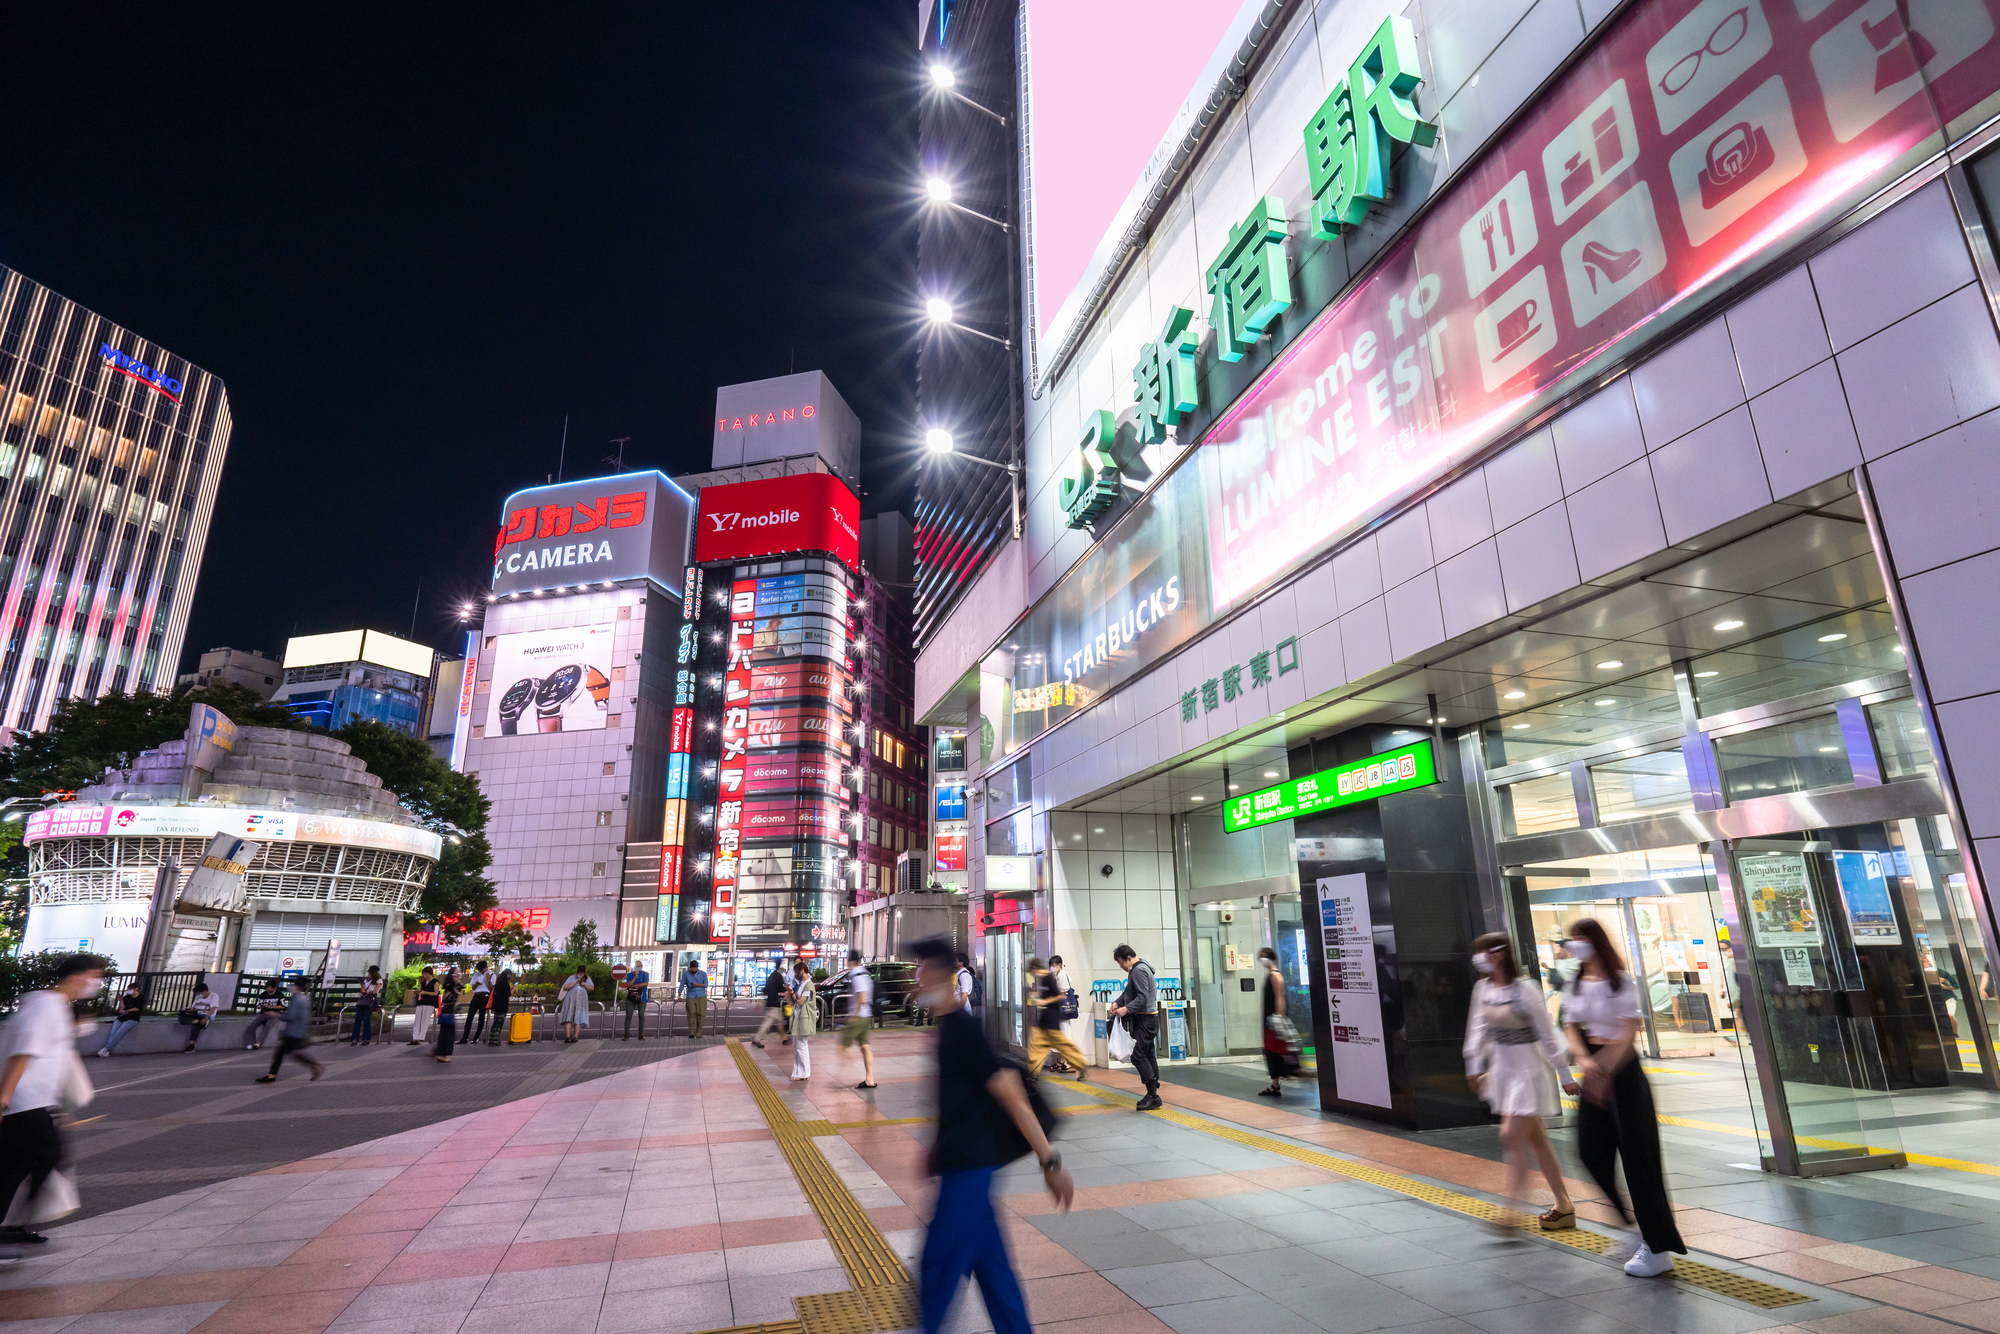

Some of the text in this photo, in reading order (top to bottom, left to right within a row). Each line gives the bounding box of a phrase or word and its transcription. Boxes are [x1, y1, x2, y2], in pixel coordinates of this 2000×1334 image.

[1132, 13, 1438, 444] 新宿駅
[1387, 272, 1441, 341] to
[98, 341, 184, 395] MIZUHO
[719, 405, 815, 431] TAKANO
[1222, 315, 1448, 547] LUMINE EST
[1059, 409, 1118, 512] JR
[506, 540, 613, 573] CAMERA
[683, 567, 695, 619] ヨドバシカメラ
[761, 595, 783, 603] Surface
[1063, 575, 1180, 686] STARBUCKS
[523, 642, 585, 655] HUAWEI WATCH 3
[763, 676, 788, 687] au
[809, 674, 830, 686] au
[1181, 635, 1298, 723] 新宿駅東口
[198, 708, 217, 752] P
[759, 719, 787, 732] au
[803, 718, 829, 730] au
[673, 768, 680, 784] UQ
[938, 799, 964, 807] ASUS
[1254, 789, 1281, 811] 新宿駅
[1297, 792, 1318, 803] East Gate
[1233, 798, 1251, 819] JR
[1255, 808, 1276, 821] Shinjuku
[1276, 805, 1295, 816] Station
[304, 821, 320, 834] 6F
[323, 821, 395, 841] WOMEN'S
[666, 809, 676, 835] au
[679, 814, 684, 832] au
[1744, 864, 1802, 877] Shinjuku Farm
[659, 906, 669, 939] SoftBank
